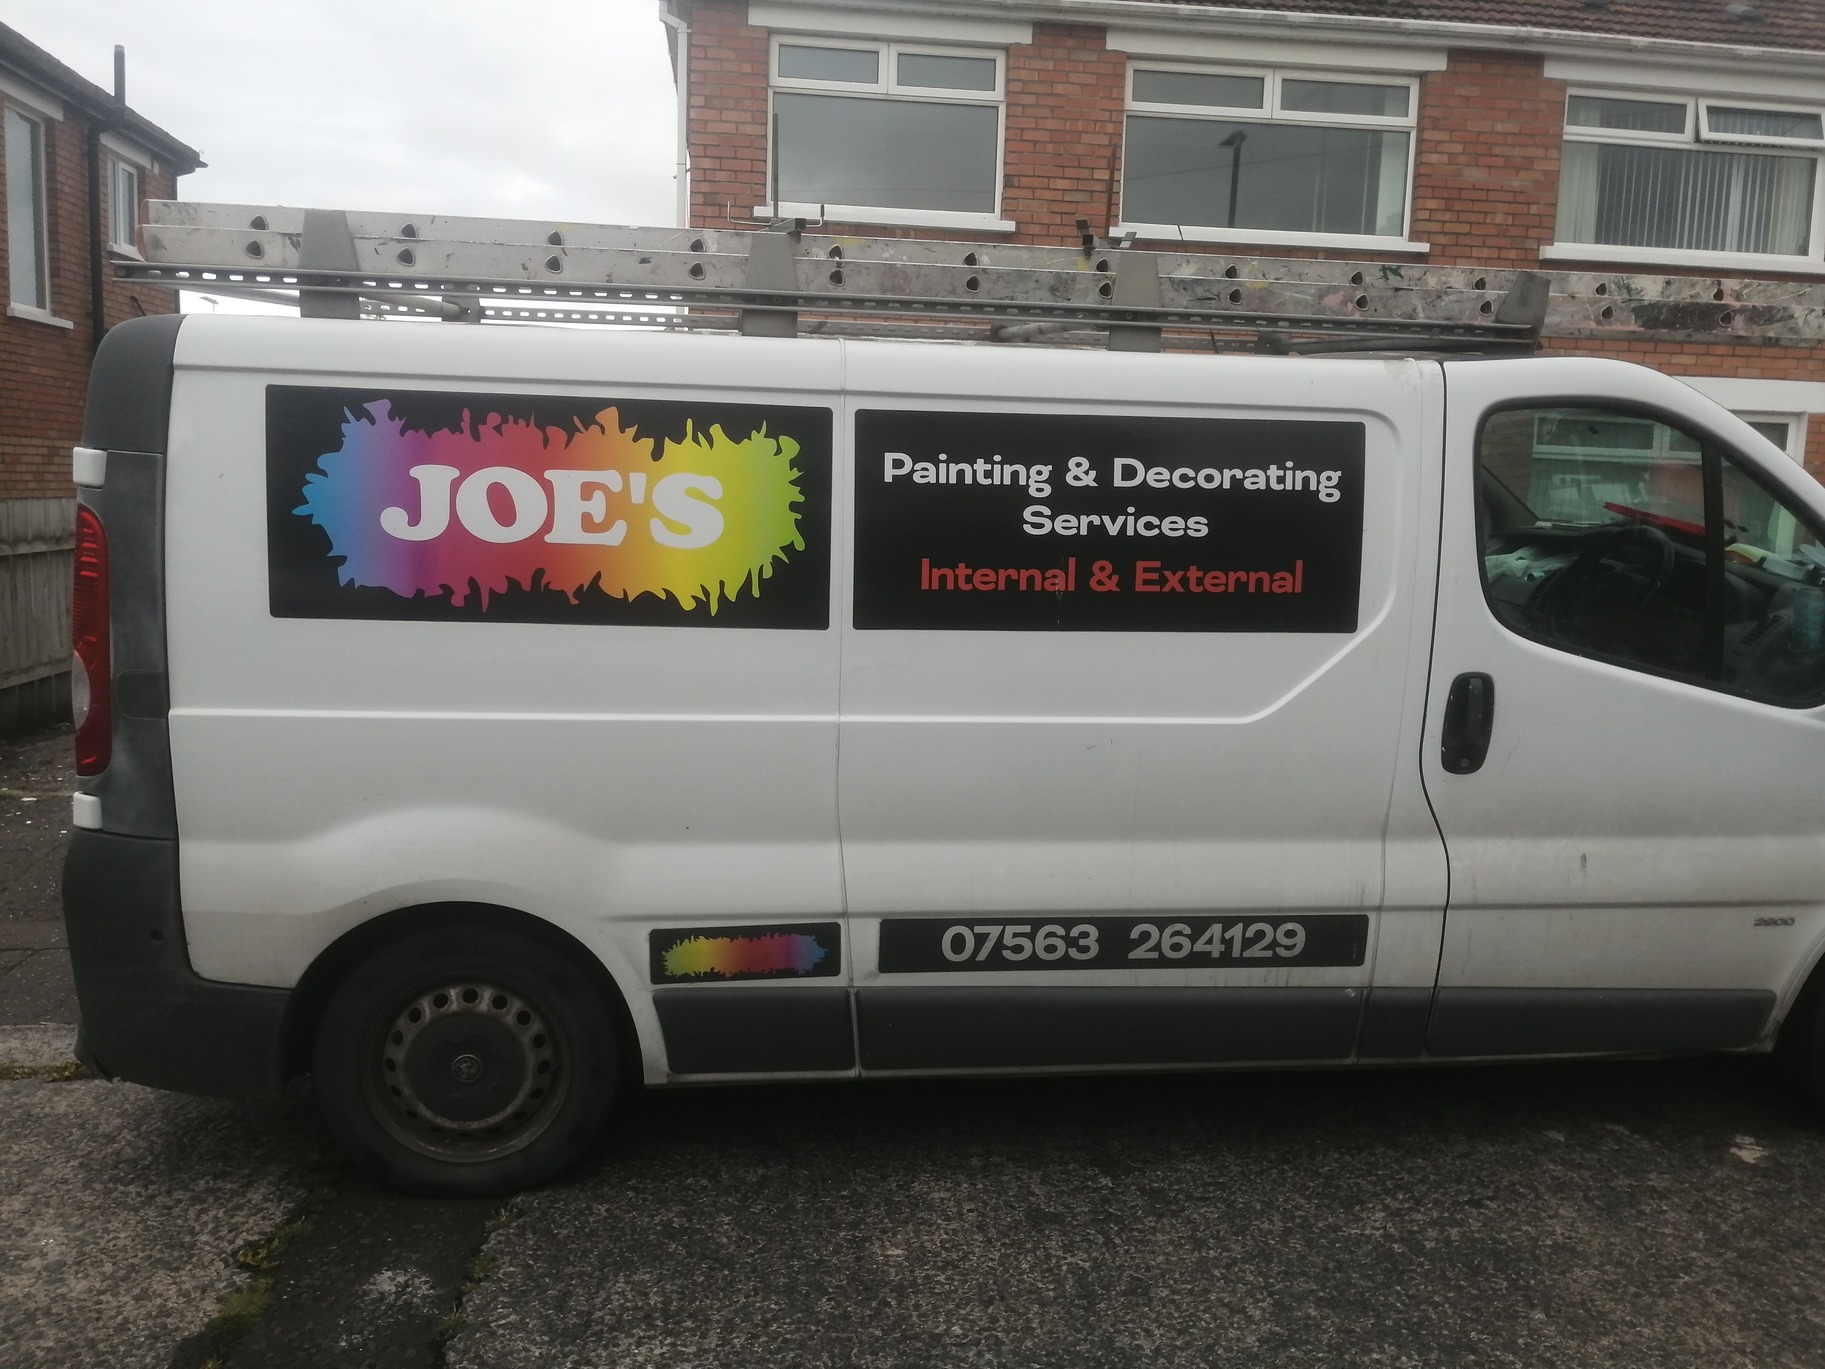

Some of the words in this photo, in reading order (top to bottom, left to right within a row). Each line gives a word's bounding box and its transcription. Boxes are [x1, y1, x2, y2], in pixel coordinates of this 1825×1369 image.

[883, 452, 1053, 498] Painting
[1065, 456, 1098, 487] &
[1113, 458, 1342, 503] Decorating
[380, 464, 725, 549] JOE'S
[1022, 505, 1209, 537] Services
[920, 557, 1077, 592] Internal
[1089, 560, 1120, 592] &
[1134, 560, 1304, 594] External
[941, 924, 1100, 962] 07563
[1127, 922, 1306, 959] 264129
